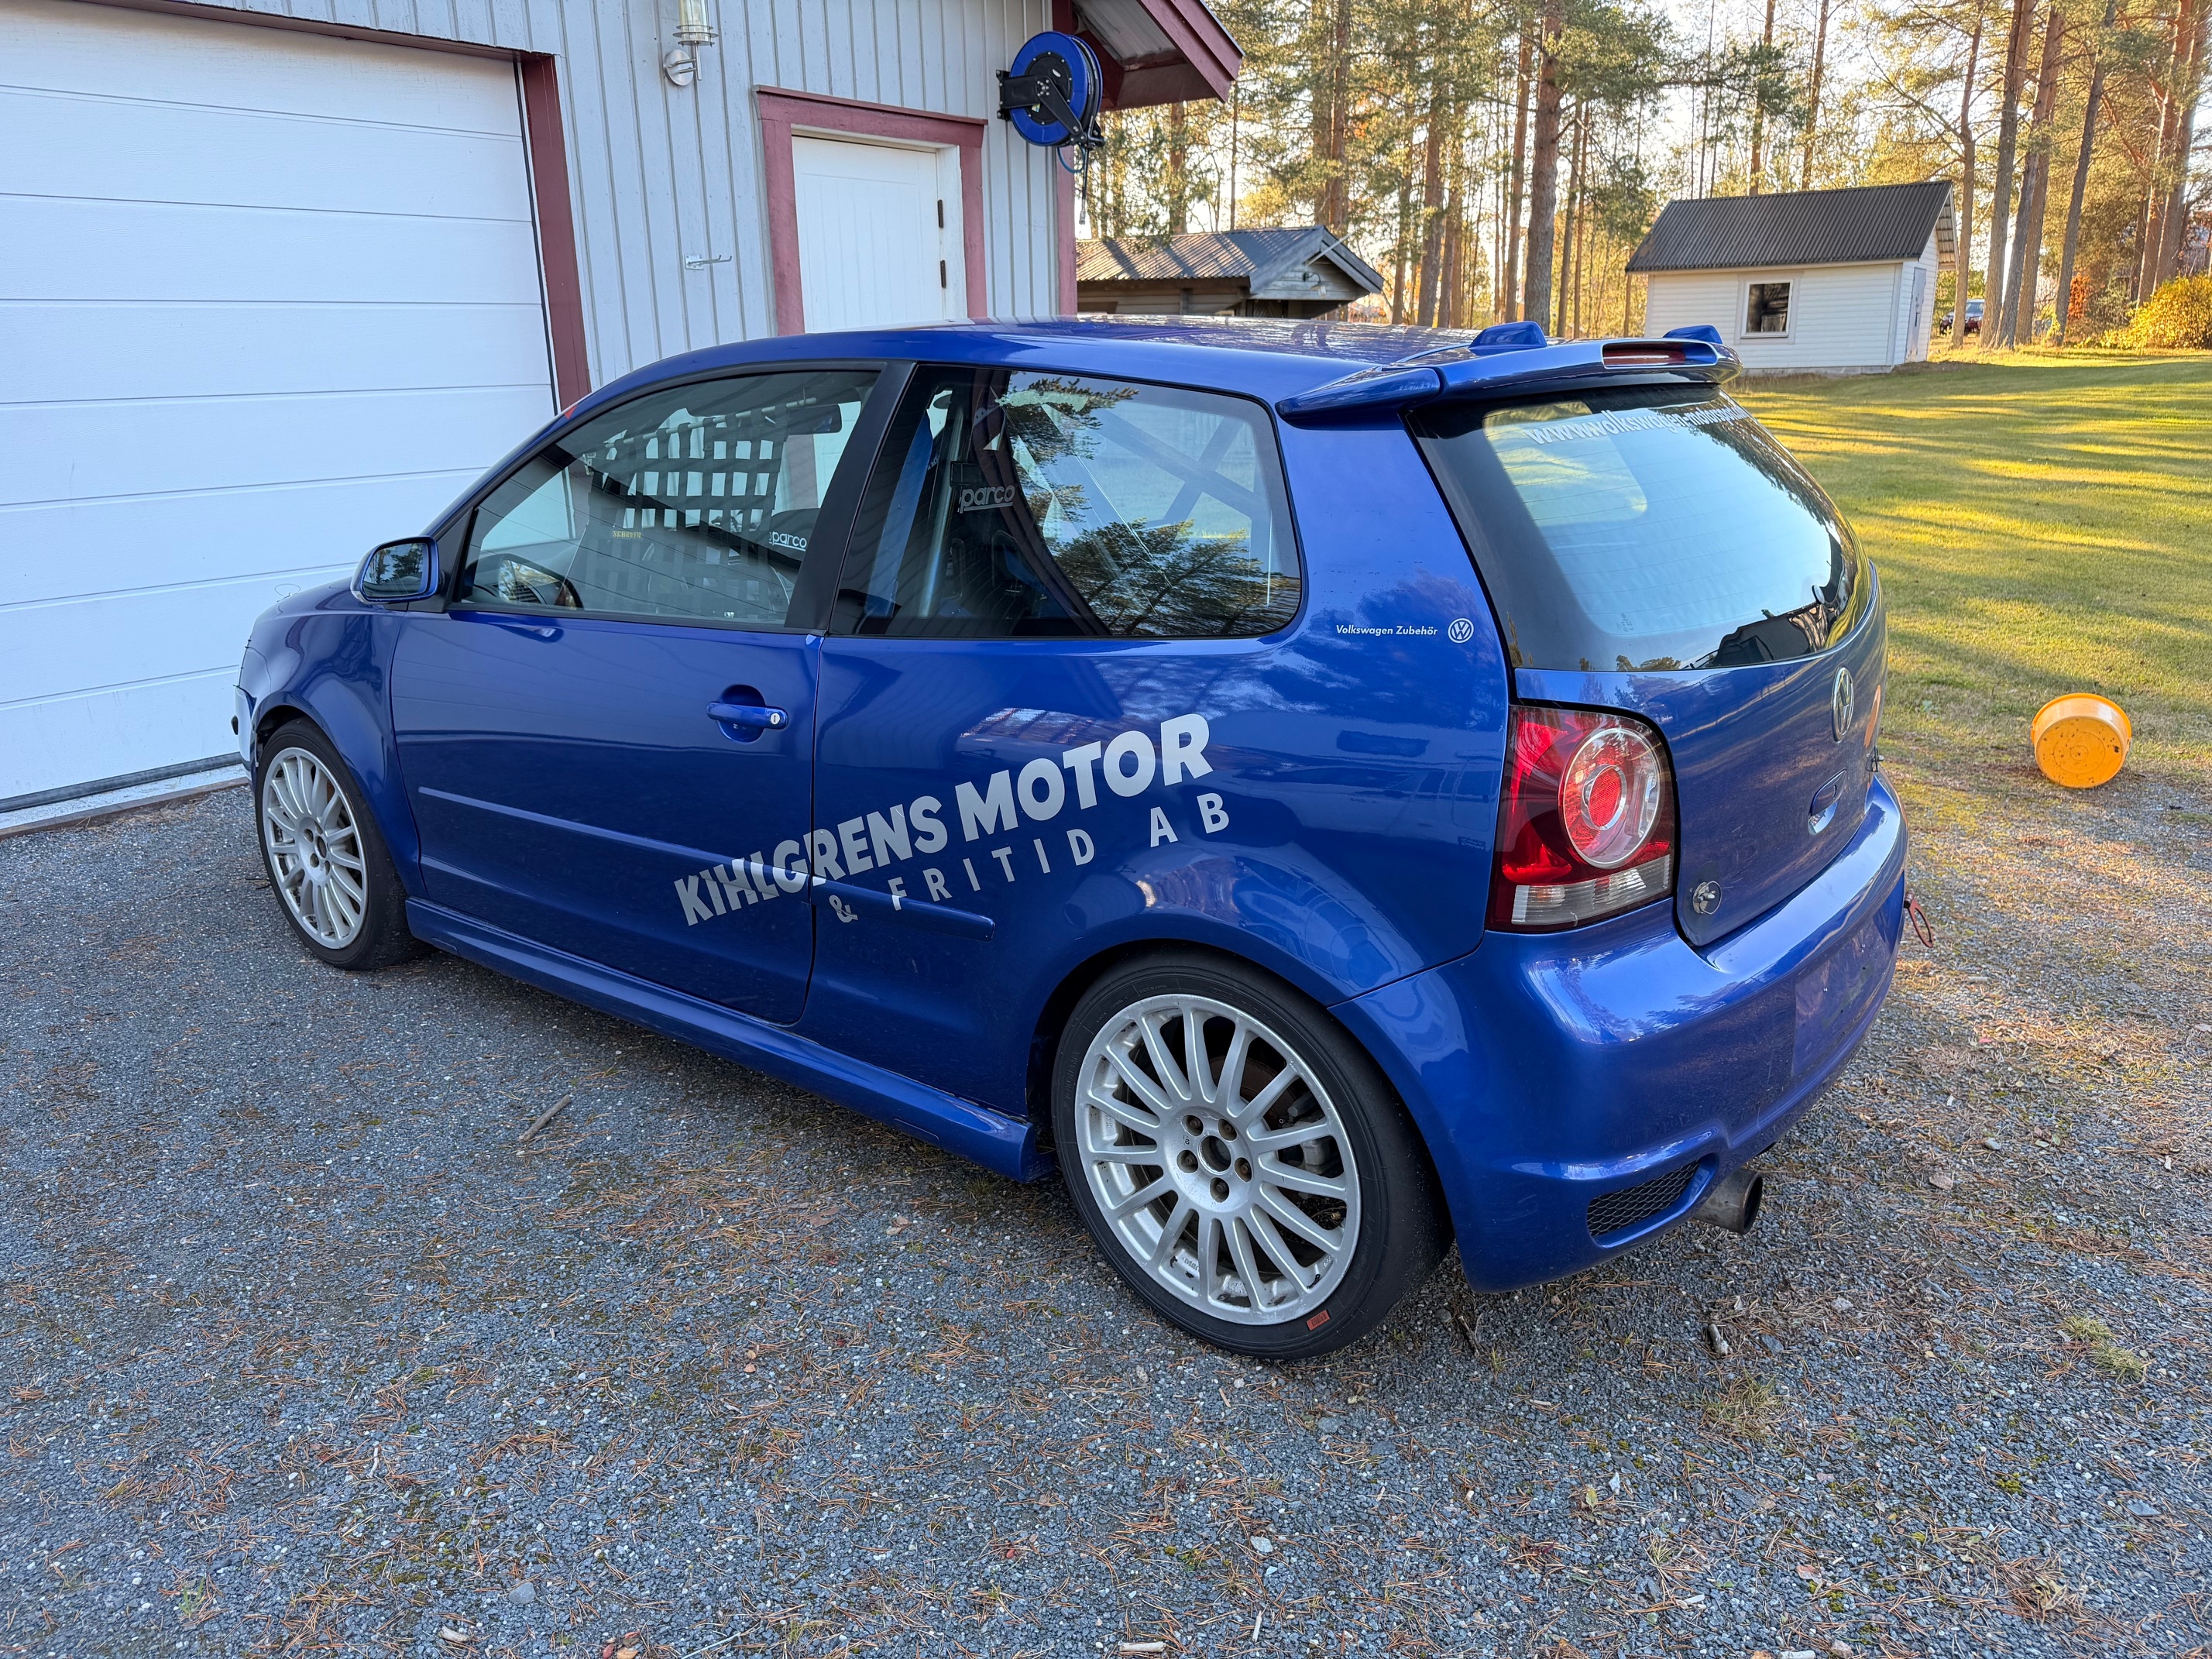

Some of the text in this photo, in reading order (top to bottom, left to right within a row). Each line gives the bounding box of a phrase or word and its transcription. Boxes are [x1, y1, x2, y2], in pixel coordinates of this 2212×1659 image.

[957, 485, 1015, 514] parco
[1336, 625, 1438, 636] Volkswagen Zubehör
[674, 713, 1213, 926] KIHLGRENS MOTOR
[829, 895, 859, 923] &
[888, 829, 1094, 911] FRITID
